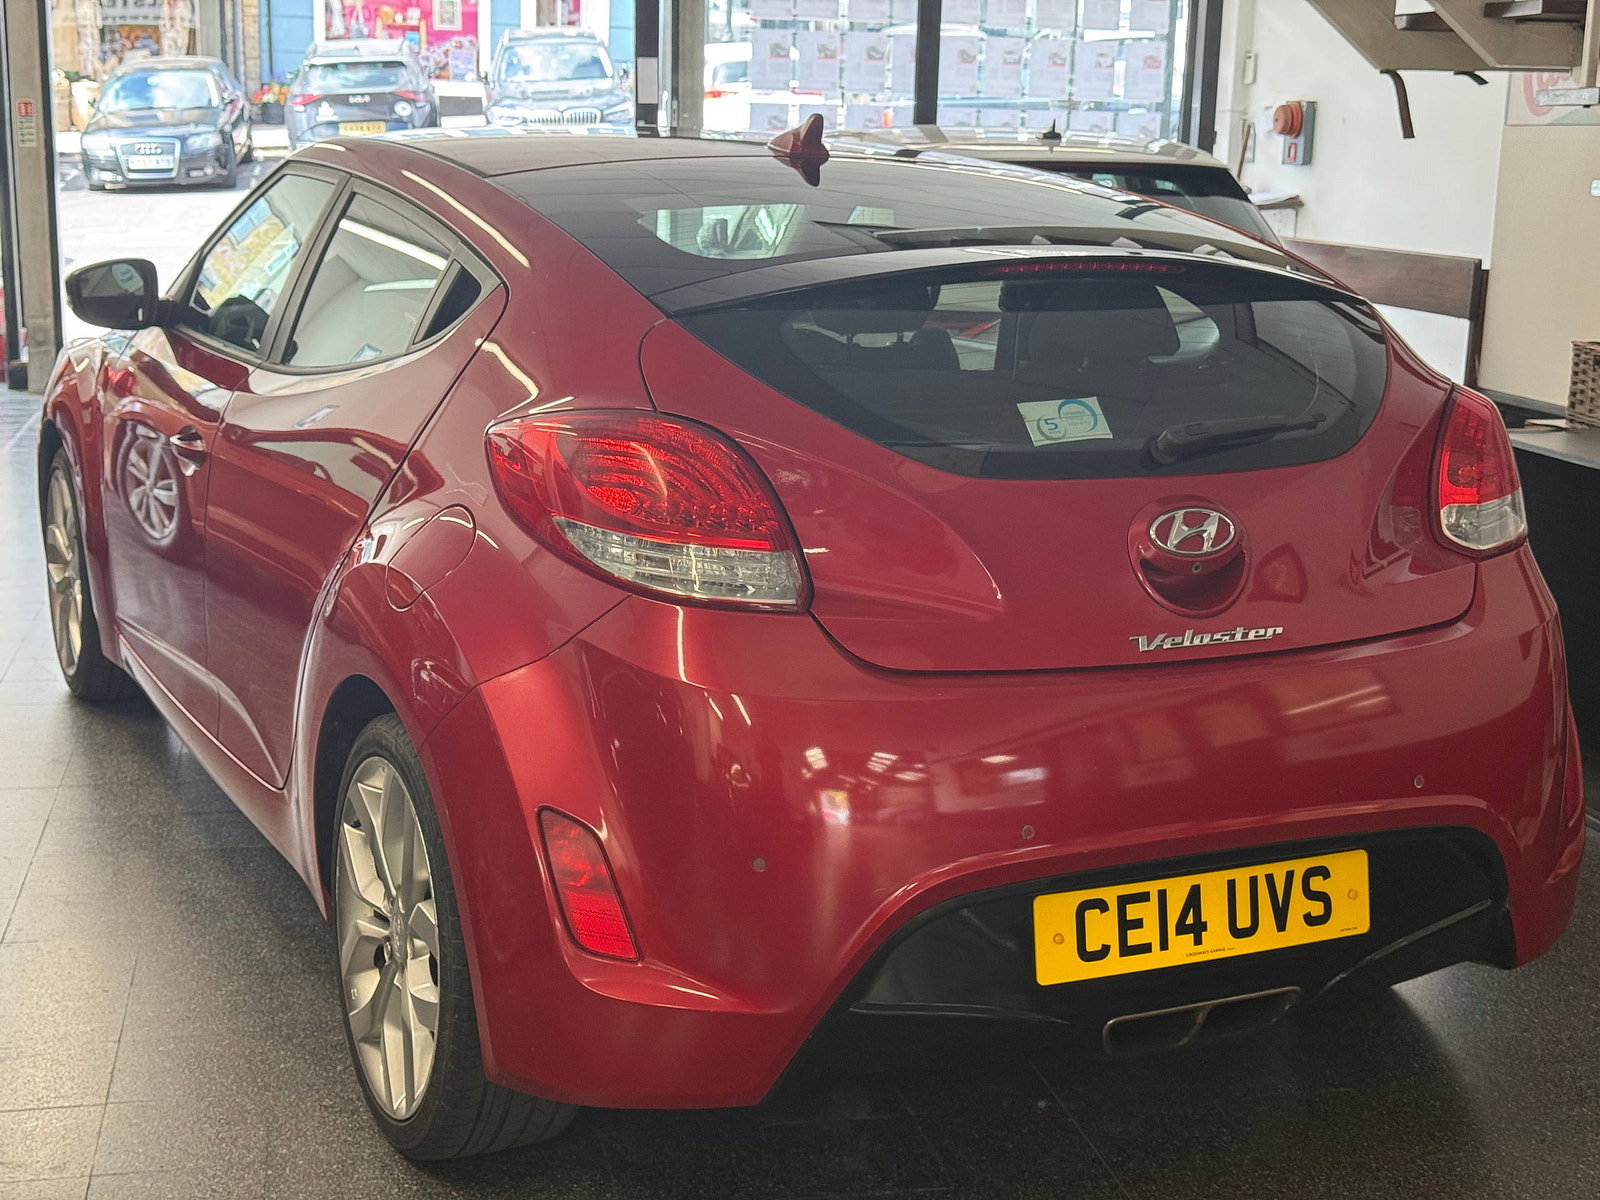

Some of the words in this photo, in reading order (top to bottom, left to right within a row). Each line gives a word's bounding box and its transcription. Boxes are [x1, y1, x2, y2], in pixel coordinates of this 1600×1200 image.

[1043, 417, 1059, 431] 5
[1128, 626, 1284, 653] Veloster
[1074, 883, 1208, 963] CE14
[1226, 865, 1333, 940] UVS
